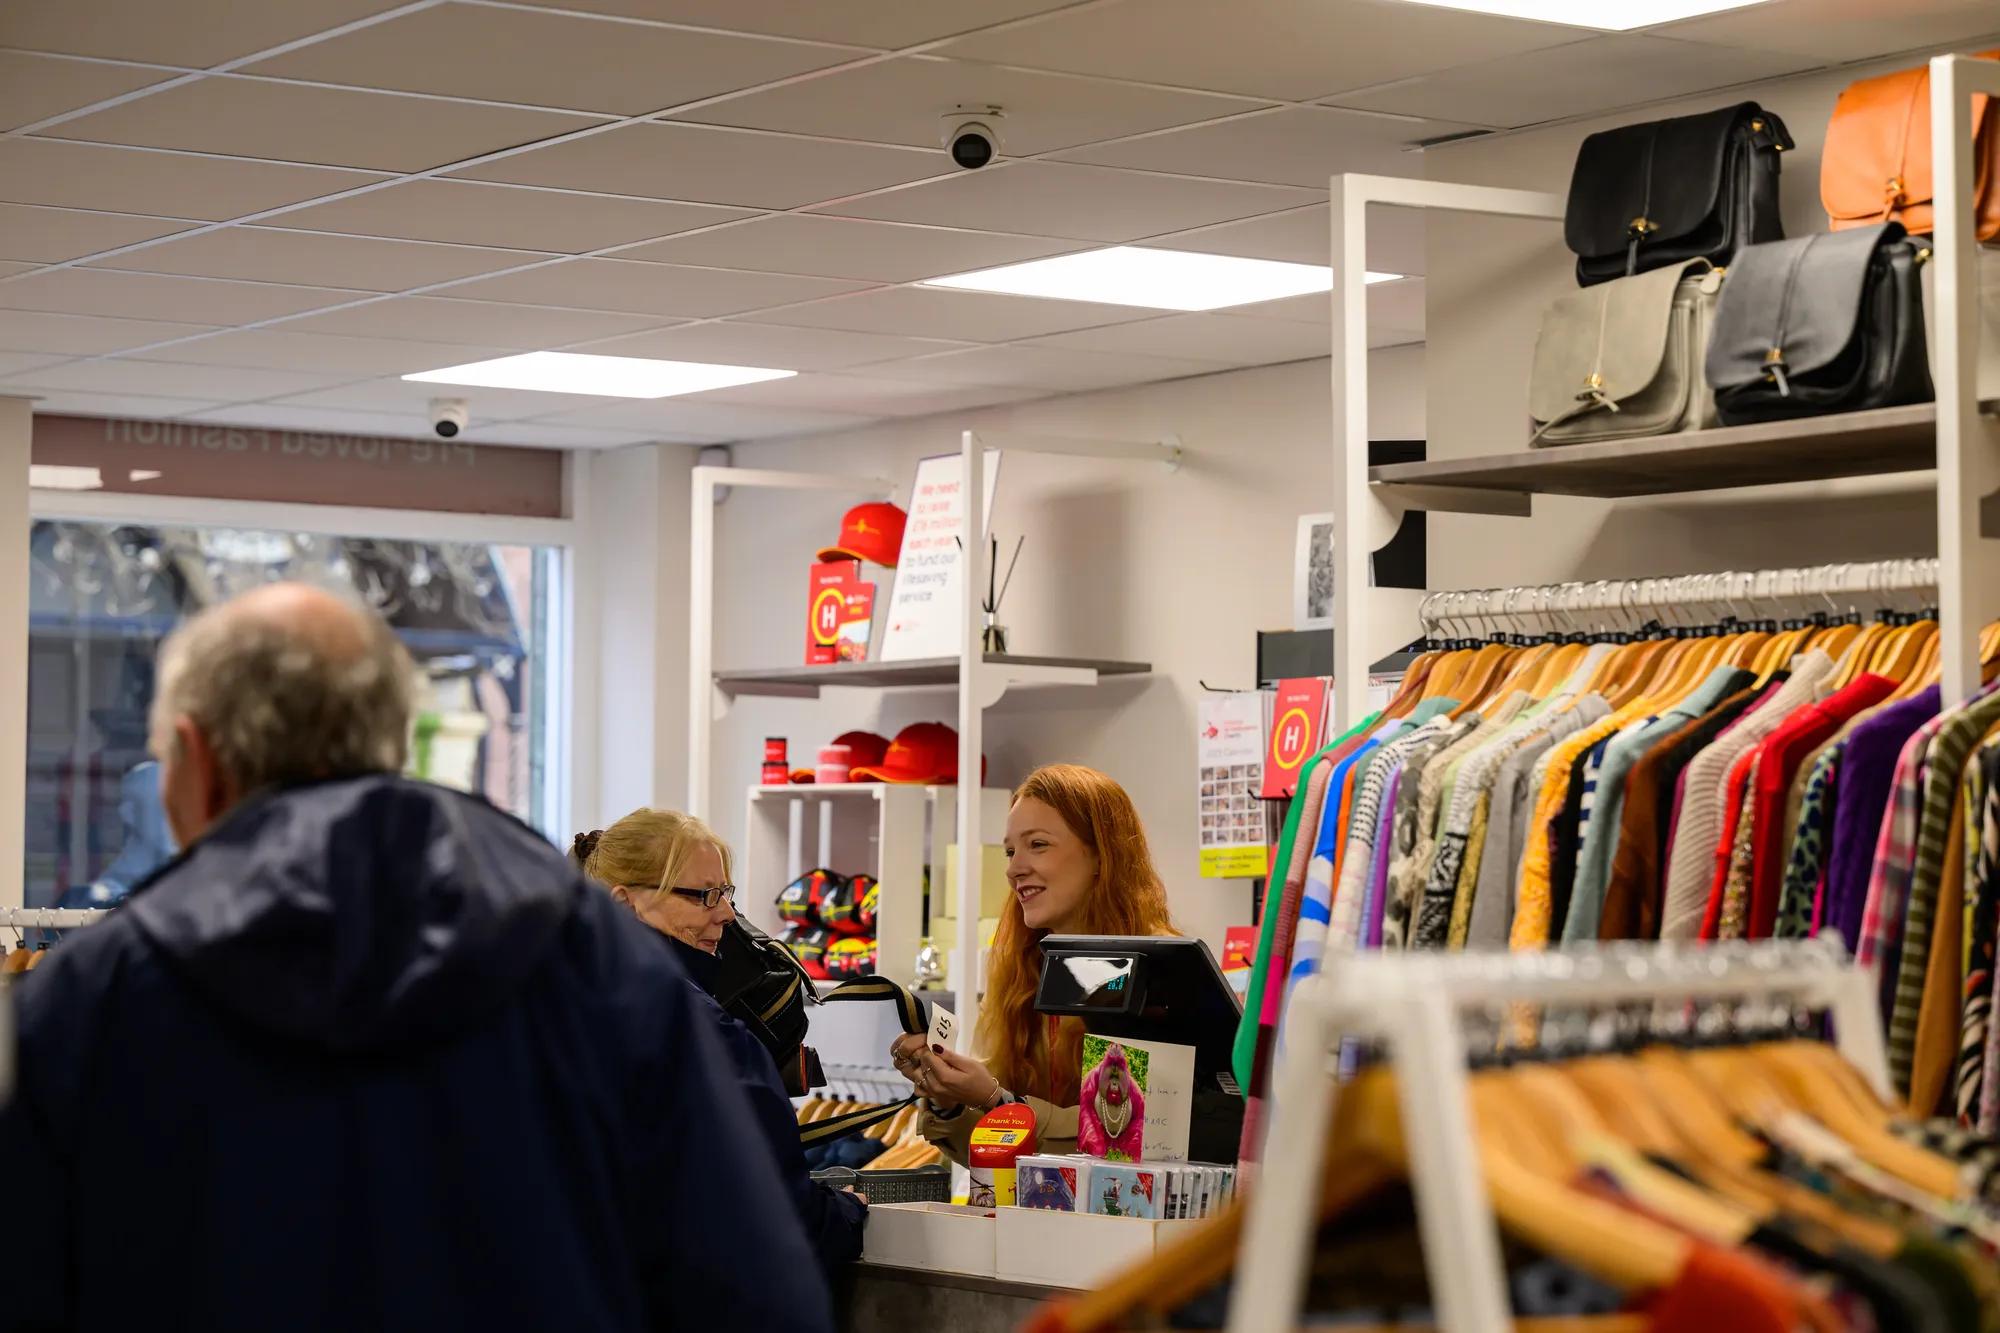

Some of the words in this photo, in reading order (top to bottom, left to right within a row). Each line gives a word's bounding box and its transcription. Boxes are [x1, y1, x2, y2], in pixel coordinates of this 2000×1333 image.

[822, 604, 836, 629] H
[1284, 726, 1300, 752] H
[936, 1015, 952, 1040] £15
[986, 1117, 1010, 1125] Thank
[1011, 1118, 1026, 1126] You
